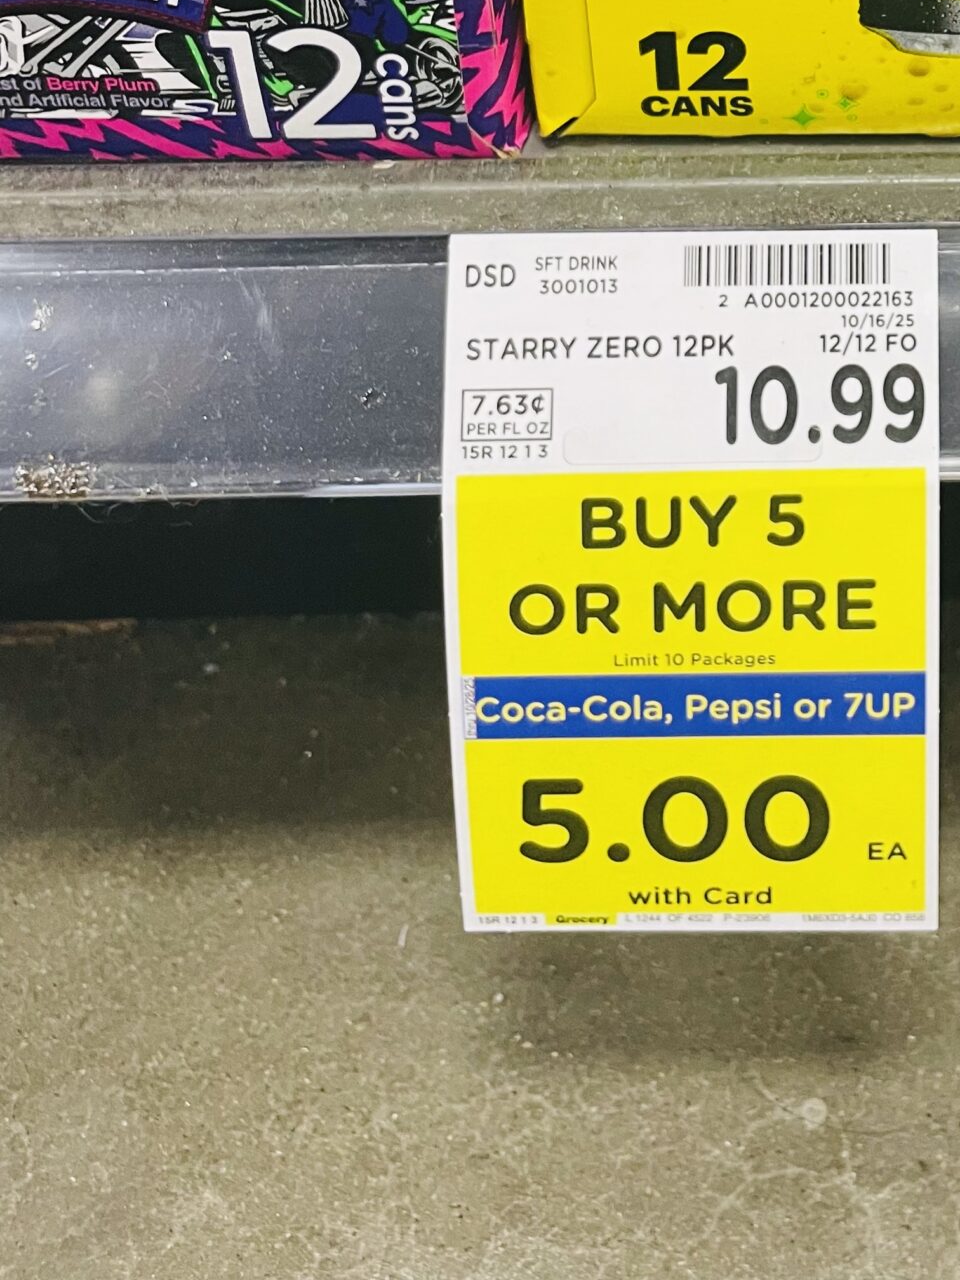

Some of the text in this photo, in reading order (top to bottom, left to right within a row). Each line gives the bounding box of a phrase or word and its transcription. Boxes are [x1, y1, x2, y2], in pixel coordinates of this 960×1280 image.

[638, 30, 750, 92] 12
[23, 76, 43, 92] of
[46, 76, 99, 94] Berry
[105, 77, 157, 92] Plum
[206, 27, 377, 140] 12
[28, 93, 106, 108] Artificial
[111, 93, 172, 108] Flavor
[376, 53, 419, 142] cans
[640, 95, 755, 117] CANS
[535, 255, 618, 271] SFT DRINK
[465, 264, 517, 288] DSD
[539, 278, 619, 294] 3001013
[718, 290, 914, 308] 2 A0001200022163
[841, 312, 915, 330] 10/16/25
[466, 334, 735, 360] STARRY ZERO 12PK
[820, 332, 918, 356] 12/12 FO
[472, 393, 545, 416] 7.63¢
[714, 362, 926, 446] 10.99
[467, 421, 550, 436] PER FL OZ
[462, 444, 549, 459] 15R 12 1 3
[581, 494, 806, 550] BUY 5
[508, 578, 878, 636] OR MORE
[613, 651, 777, 671] Limit 10 Packages
[475, 691, 916, 726] Coca-Cola, Pepsi or 7UP
[519, 775, 907, 864] 5.00 EA
[629, 886, 773, 906] with Card
[556, 914, 609, 926] Grocery
